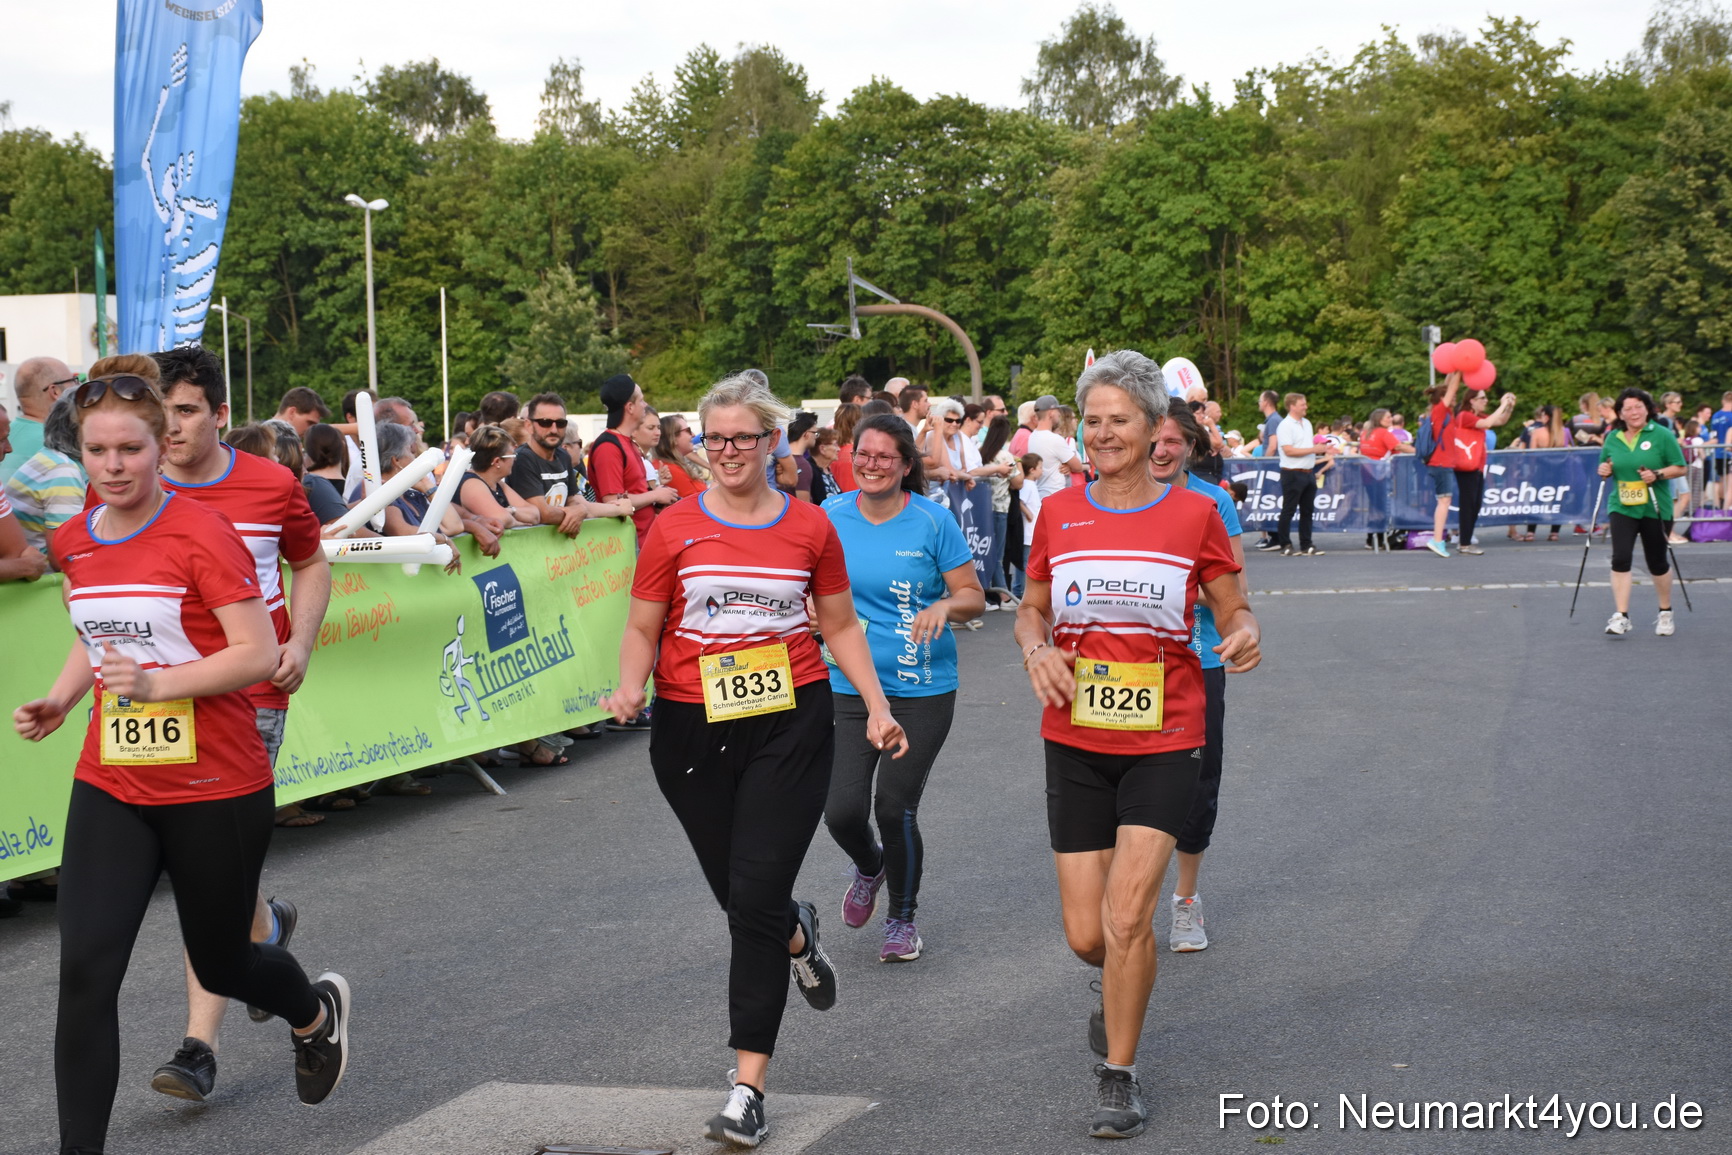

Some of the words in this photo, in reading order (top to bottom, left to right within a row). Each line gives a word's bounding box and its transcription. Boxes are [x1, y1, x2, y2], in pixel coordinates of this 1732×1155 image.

[1482, 481, 1570, 504] scher
[895, 550, 924, 558] Nathalie
[489, 588, 517, 609] Fischer
[723, 590, 793, 611] Petry
[1086, 578, 1165, 601] Petry
[1086, 598, 1113, 606] WÄRME
[1116, 599, 1139, 607] KÄLTE
[1142, 602, 1163, 610] KLIMA
[83, 619, 153, 639] Petry
[473, 614, 576, 698] firmenlauf
[922, 642, 933, 684] Nathalie
[715, 669, 782, 701] 1833
[491, 680, 536, 713] neumarkt
[712, 697, 766, 710] Schneiderbauer
[767, 692, 789, 701] Carina
[1084, 684, 1152, 711] 1826
[1090, 709, 1111, 717] Janko
[1112, 711, 1144, 720] Angelika
[110, 717, 181, 744] 1816
[119, 745, 141, 753] Braun
[142, 744, 170, 752] Kerstin
